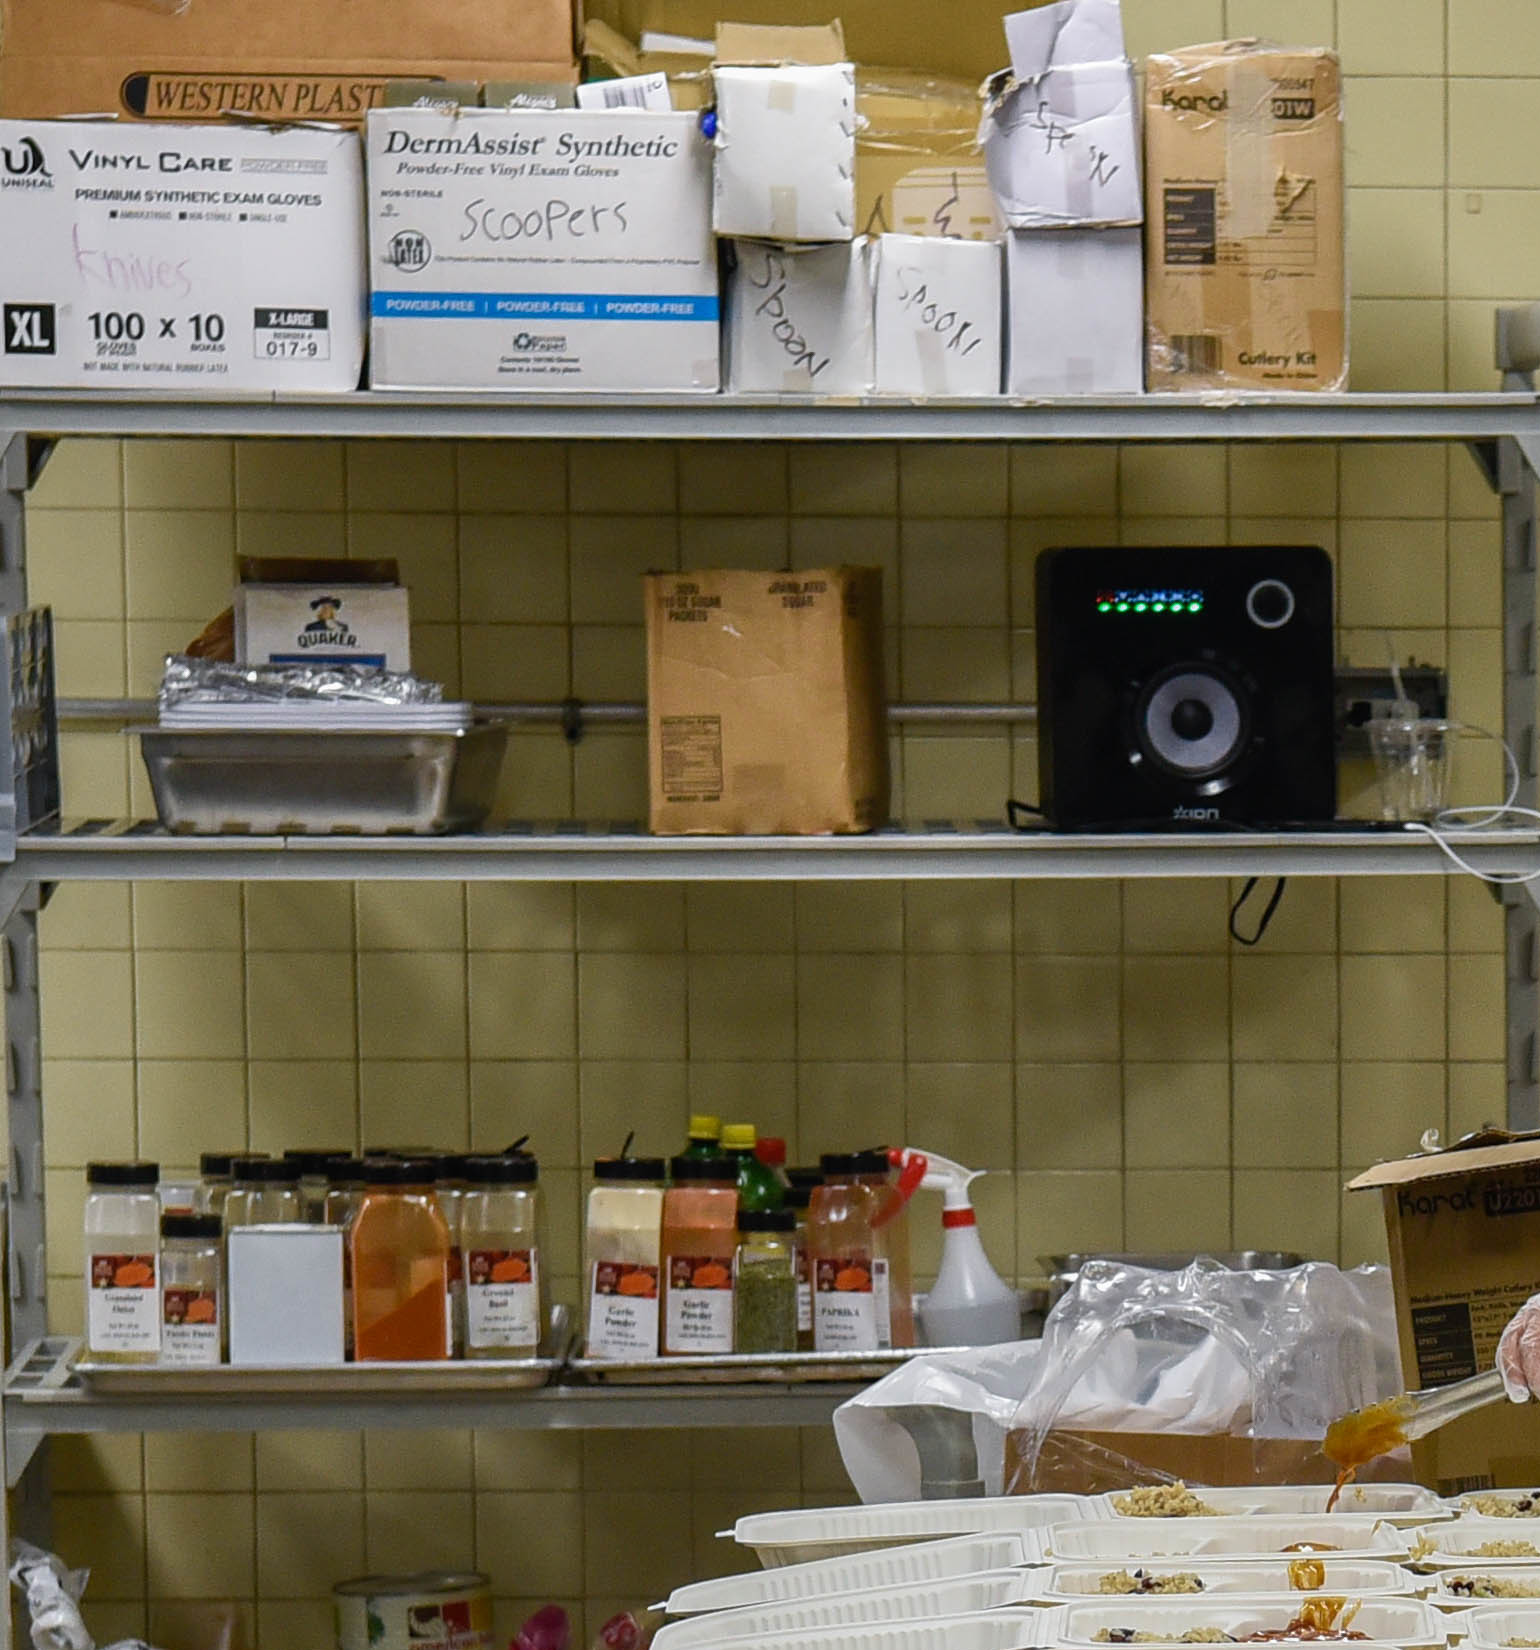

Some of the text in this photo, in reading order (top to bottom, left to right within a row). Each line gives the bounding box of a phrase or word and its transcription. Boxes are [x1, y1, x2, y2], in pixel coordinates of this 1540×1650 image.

[155, 80, 291, 111] WESTERN
[384, 130, 679, 163] DermAssist Synthetic
[396, 162, 620, 179] Powder-Free Vinyl Exam Gloves
[75, 189, 323, 206] PREMIUM SYNTHETIC EXAM GLOVES
[386, 299, 694, 316] POWDER-FREE POWDER-FREE POWDER-FREE
[88, 312, 145, 341] 100
[189, 313, 224, 342] 10
[267, 312, 315, 328] X-LARGE
[10, 311, 50, 348] XL
[266, 341, 318, 357] 017-9
[1237, 351, 1317, 369] Cutlery Kit
[297, 632, 358, 648] QUAKER
